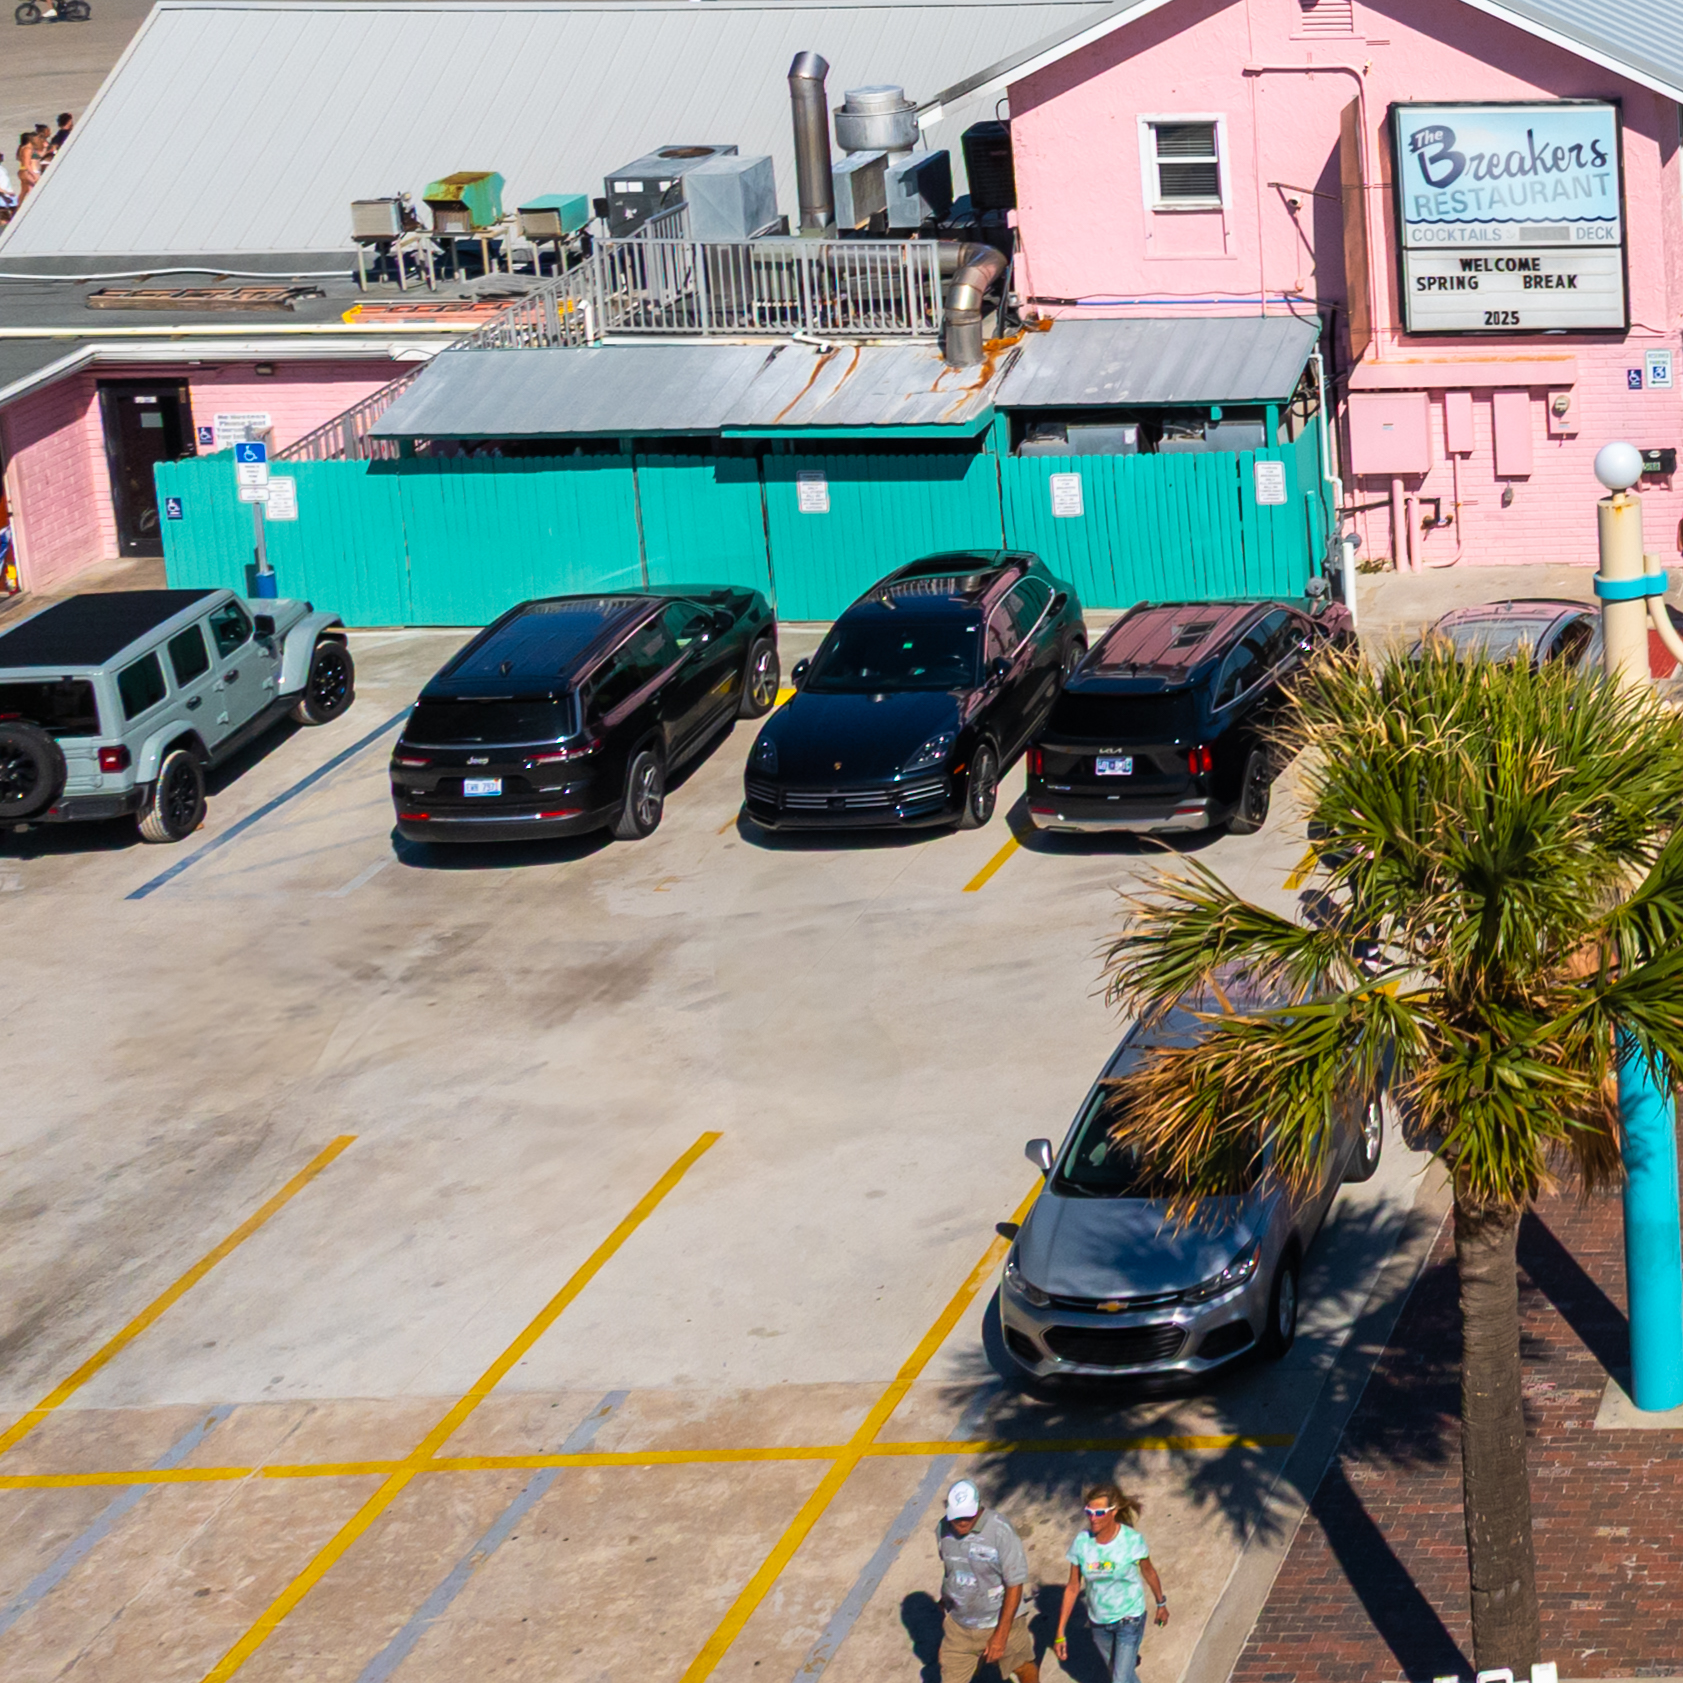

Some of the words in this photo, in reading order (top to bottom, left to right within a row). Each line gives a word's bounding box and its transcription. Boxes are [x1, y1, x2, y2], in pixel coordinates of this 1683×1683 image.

[1415, 129, 1444, 149] The
[1408, 125, 1608, 189] Breakers
[1414, 172, 1610, 218] RESTAURANT
[1412, 228, 1502, 242] COCKTAILS
[1576, 226, 1614, 240] DECK
[1459, 257, 1541, 272] WELCOME
[1417, 276, 1479, 291] SPRING
[1523, 275, 1577, 289] BREAK
[1484, 311, 1520, 325] 2025
[466, 756, 489, 766] Jeep
